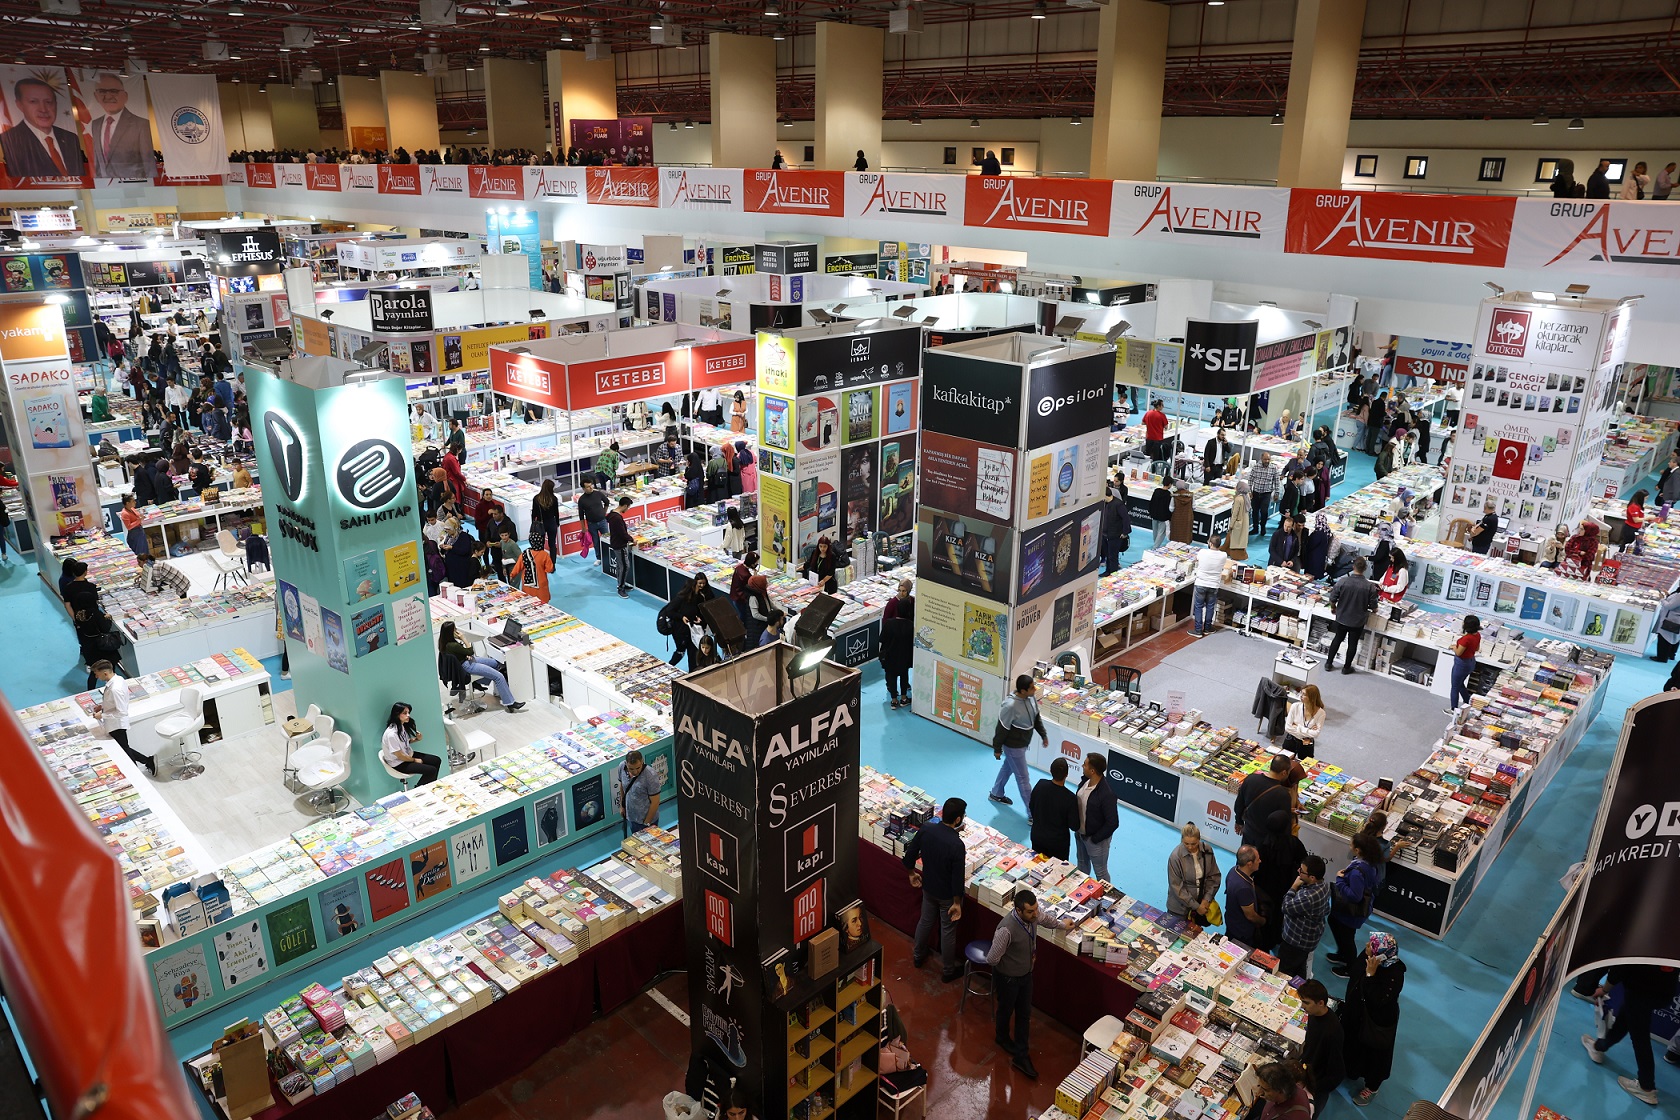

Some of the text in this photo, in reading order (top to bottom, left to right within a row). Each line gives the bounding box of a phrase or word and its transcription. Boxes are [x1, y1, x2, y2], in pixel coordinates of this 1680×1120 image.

[252, 166, 272, 186] AVENIR
[281, 166, 303, 187] AVENIR
[312, 166, 337, 190] AVENIR
[347, 167, 374, 191] AVENIR
[386, 167, 415, 192] AVENIR
[428, 167, 463, 195] AVENIR
[477, 168, 516, 198] AVENIR
[668, 171, 682, 179] GRUP
[755, 172, 771, 181] GRUP
[859, 174, 878, 184] GRUP
[534, 169, 578, 199] AVENIR
[597, 170, 650, 203] AVENIR
[671, 171, 732, 206] AVENIR
[757, 172, 830, 211] AVENIR
[983, 178, 1006, 190] GRUP
[1134, 185, 1162, 198] GRUP
[860, 175, 947, 216] AVENIR
[983, 179, 1089, 226] AVENIR
[1315, 194, 1350, 208] GRUP
[1132, 187, 1262, 237] AVENIR
[1550, 202, 1595, 218] GRUP
[1313, 195, 1475, 251] AVENIR
[232, 251, 273, 262] EPHESUS
[725, 254, 751, 262] ERCİYES
[827, 263, 853, 272] ERCİYES
[385, 309, 428, 321] yayınları
[1540, 320, 1589, 334] her zaman
[1537, 332, 1582, 345] okunacak
[850, 354, 870, 363] ithaki
[1421, 347, 1446, 357] yayın
[1487, 344, 1523, 357] ÖTÜKEN
[709, 357, 744, 370] KETEBE
[1407, 360, 1435, 377] %30
[9, 369, 70, 385] SADAKO
[509, 368, 548, 389] KETEBE
[601, 368, 661, 388] KETEBE
[765, 366, 788, 378] ithaki
[1508, 372, 1546, 384] CENGİZ
[1510, 381, 1541, 393] DAĞCI
[28, 402, 59, 414] SADAKO
[1493, 429, 1537, 443] SEYFETTİN
[1504, 423, 1529, 435] ÖMER
[1486, 486, 1520, 499] AKÇURA
[1492, 480, 1517, 492] YUSUF
[64, 515, 80, 525] BTS
[1192, 520, 1208, 536] EL
[945, 535, 963, 546] KIZ A
[975, 551, 987, 561] KIZ
[1016, 610, 1041, 631] HOOVER
[845, 651, 869, 666] ithaki
[677, 713, 748, 768] ALFA
[762, 702, 854, 769] ALFA
[694, 744, 736, 773] YAYINLARI
[785, 737, 839, 771] YAYINLARI
[680, 759, 750, 822] SEVEREST
[1109, 769, 1173, 800] epsilon
[768, 763, 851, 829] SEVEREST
[1205, 820, 1230, 835] uçan fil
[706, 853, 729, 877] kapı
[798, 851, 824, 873] kapı
[1594, 840, 1672, 876] API KREDİ
[798, 886, 818, 918] MO
[1388, 884, 1438, 909] silon
[708, 896, 725, 919] MO
[207, 915, 215, 926] 1
[711, 916, 725, 938] NA
[800, 911, 816, 937] NA
[180, 926, 188, 938] 2
[279, 928, 309, 953] GÖLET
[173, 967, 192, 980] Rüya
